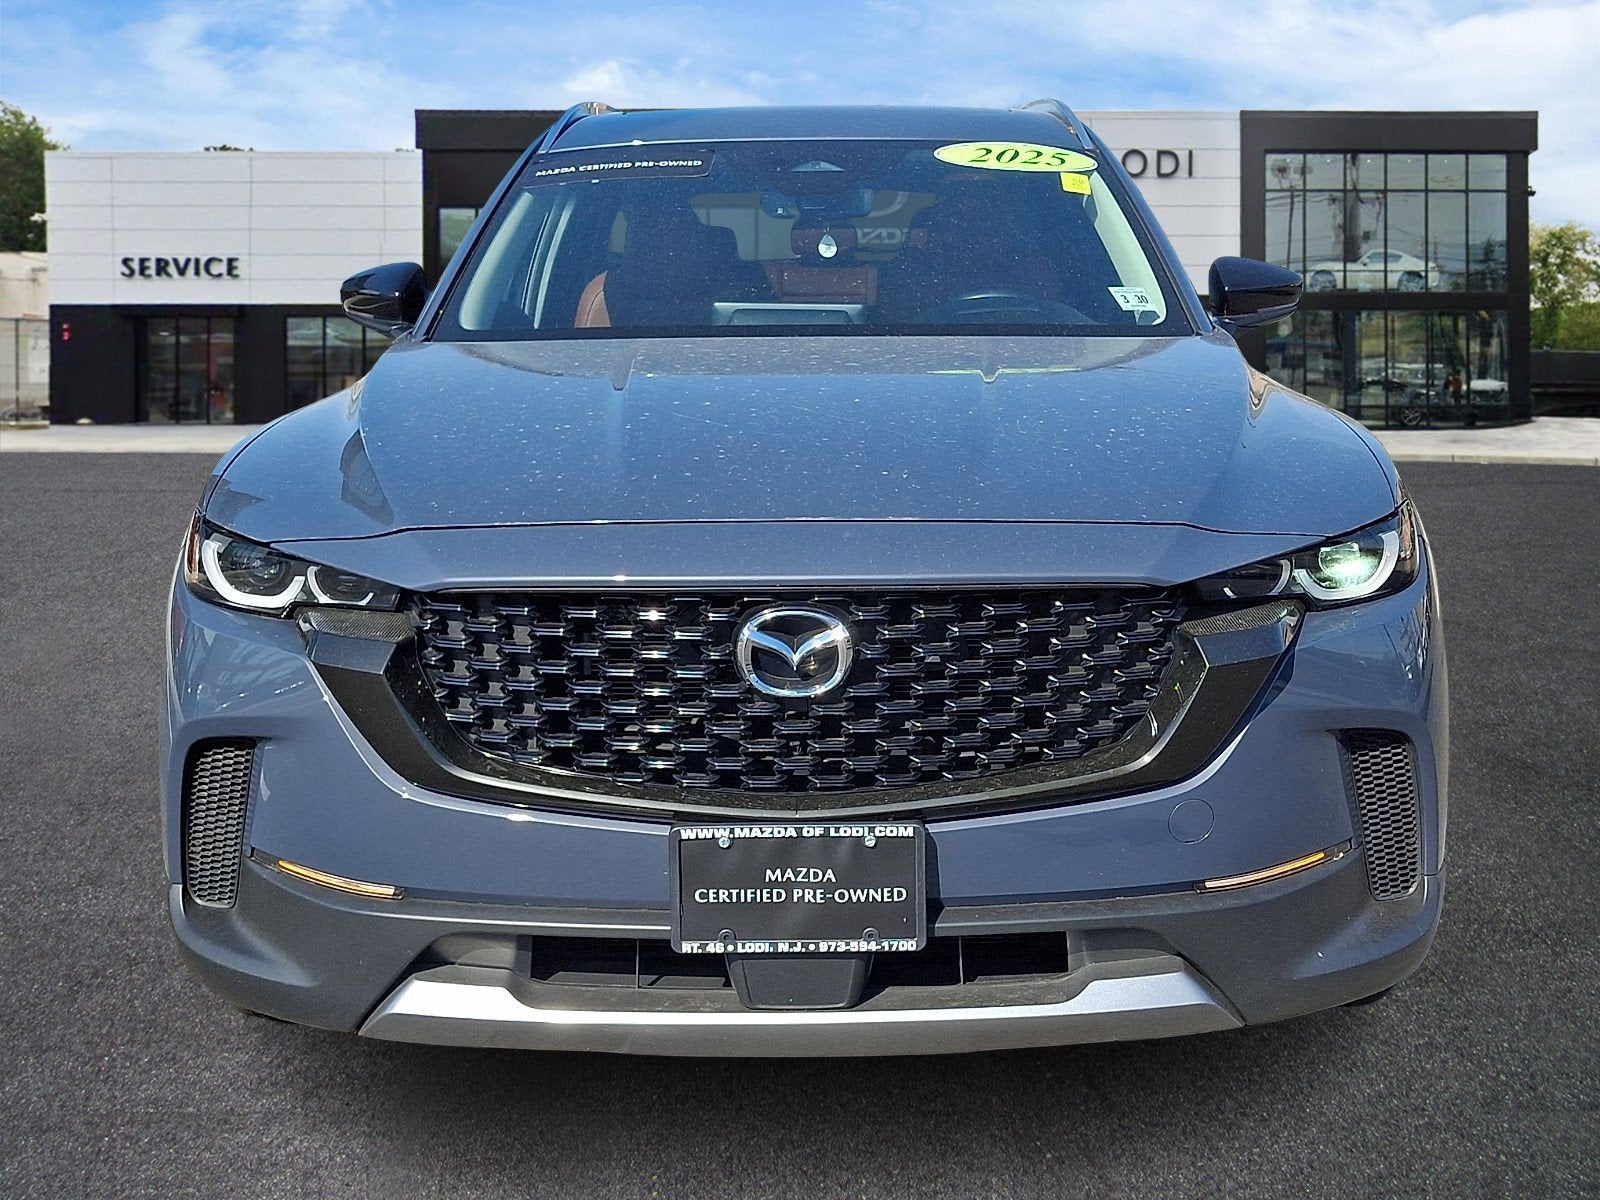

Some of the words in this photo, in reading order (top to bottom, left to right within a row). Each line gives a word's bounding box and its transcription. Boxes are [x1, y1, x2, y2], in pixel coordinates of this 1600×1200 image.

[968, 147, 1070, 167] 2025
[1121, 149, 1193, 178] ODI
[535, 166, 577, 177] MAZDA
[578, 162, 633, 172] CERTIFIED
[634, 160, 703, 168] PRE-OWNED
[120, 256, 240, 279] SERVICE
[1120, 294, 1130, 304] 3
[1134, 294, 1149, 304] 30
[680, 827, 798, 840] WWW.MAZDA
[802, 826, 825, 837] OF
[829, 826, 914, 837] LODI.COM
[765, 867, 837, 883] MAZDA
[694, 888, 787, 903] CERTIFIED
[793, 887, 907, 903] PRE-OWNED
[681, 942, 703, 954] RT.
[705, 942, 725, 953] 46
[819, 940, 917, 952] 973-594-1700
